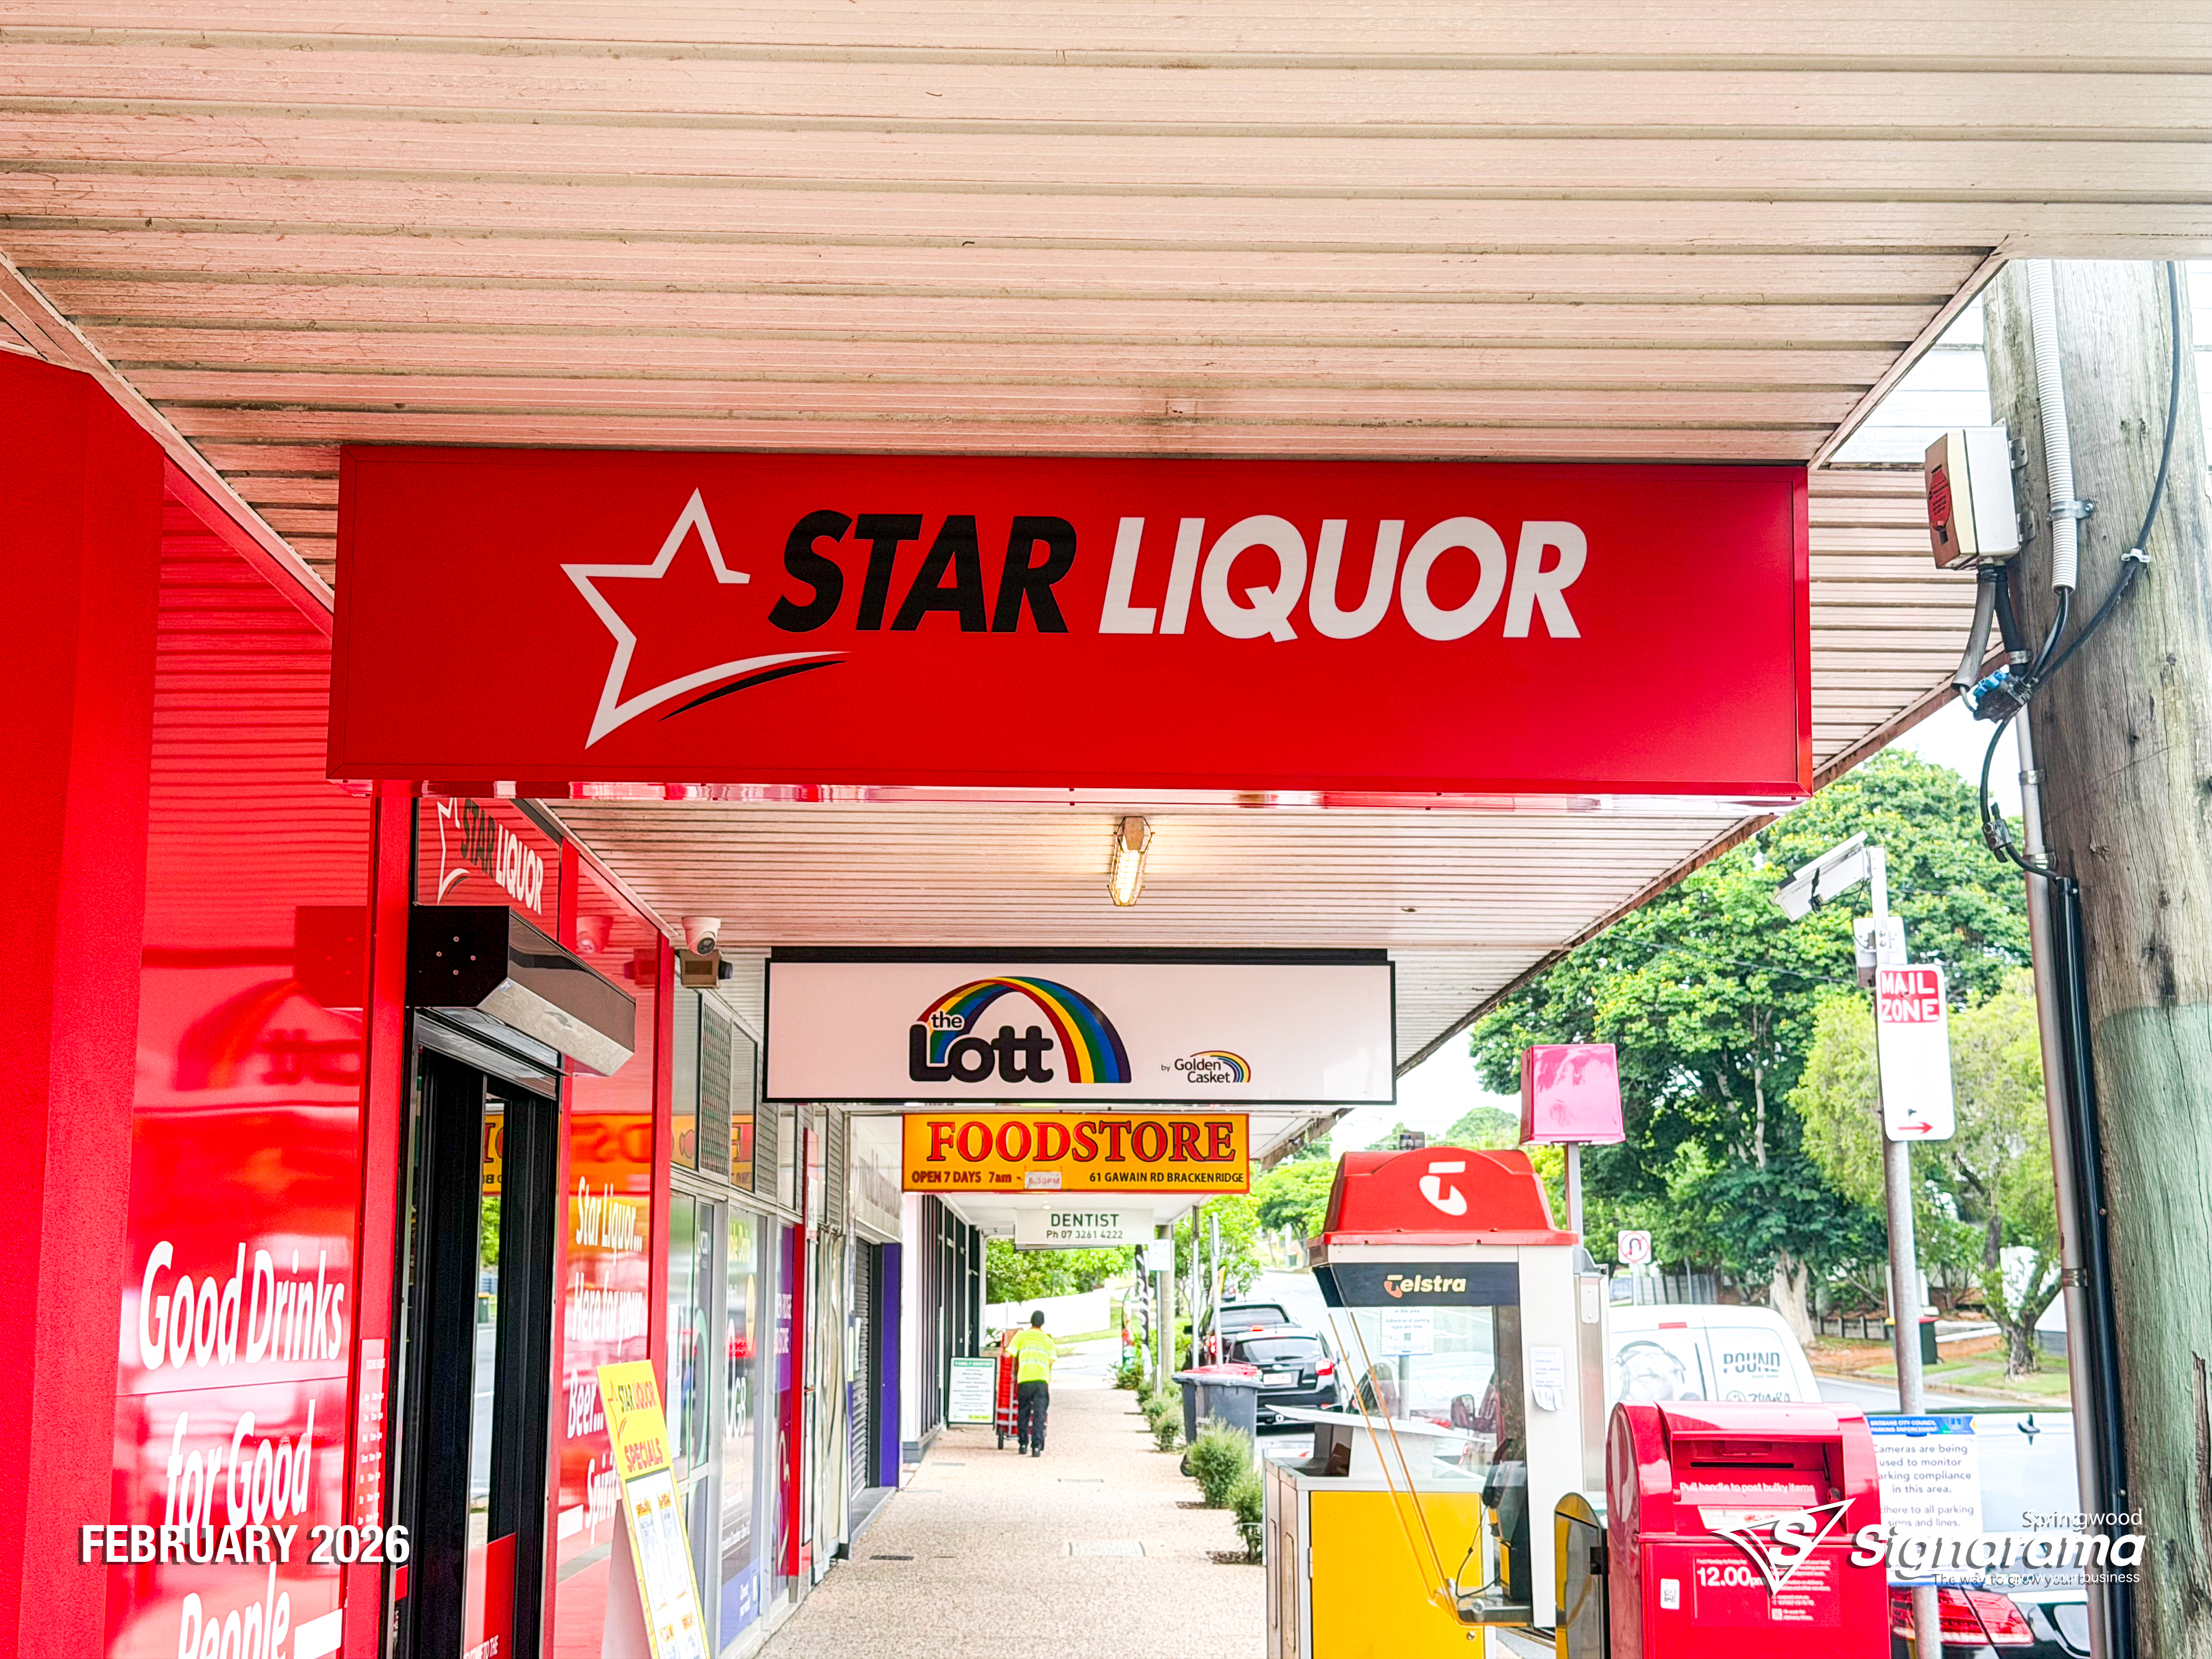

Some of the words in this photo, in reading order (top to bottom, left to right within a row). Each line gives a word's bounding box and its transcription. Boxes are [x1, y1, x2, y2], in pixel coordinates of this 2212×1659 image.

[768, 510, 1077, 633] STAR
[1098, 514, 1588, 643] LIQUOR
[460, 798, 495, 879] STAR
[495, 823, 543, 915] LIQUOR
[1881, 972, 1935, 995] MAIL
[931, 1011, 963, 1028] the
[1882, 999, 1939, 1021] ZONE
[909, 1024, 1054, 1083] Lott
[1174, 1058, 1221, 1071] Golden
[1187, 1071, 1231, 1083] Casket
[926, 1120, 1236, 1162] FOODSTORE
[911, 1170, 941, 1183] OPEN
[944, 1171, 950, 1182] 7
[953, 1171, 981, 1183] DAYS
[988, 1171, 1012, 1183] 7am
[1089, 1172, 1101, 1182] 61
[1104, 1172, 1147, 1182] GAWAIN
[1150, 1173, 1164, 1182] RD
[1167, 1173, 1244, 1183] BRACKENRIDGE
[576, 1176, 602, 1246] Star
[1051, 1214, 1119, 1227] DENTIST
[1046, 1230, 1058, 1238] Ph
[1384, 1274, 1466, 1298] Telstra
[139, 1240, 246, 1370] Good
[246, 1249, 345, 1364] Drinks
[572, 1272, 601, 1341] Here
[602, 1269, 619, 1339] for
[617, 1290, 643, 1357] your
[1723, 1352, 1780, 1373] POUND
[618, 1384, 635, 1413] STAR
[624, 1437, 663, 1472] SPECIALS
[1873, 1444, 1916, 1453] Cameras
[1938, 1443, 1968, 1455] being
[1880, 1457, 1903, 1466] used
[1921, 1457, 1962, 1466] monitor
[165, 1412, 222, 1547] for
[227, 1399, 316, 1531] Good
[1878, 1470, 1910, 1482] arking
[1914, 1470, 1971, 1482] compliance
[1680, 1482, 1697, 1492] Pull
[1699, 1482, 1729, 1492] handle
[1730, 1483, 1741, 1492] to
[1742, 1483, 1762, 1492] post
[1763, 1482, 1788, 1492] bulky
[1892, 1484, 1901, 1493] in
[1905, 1484, 1923, 1493] this
[1881, 1505, 1908, 1514] dhere
[1925, 1504, 1934, 1514] all
[1938, 1504, 1974, 1516] parking
[1915, 1517, 1933, 1527] and
[1936, 1518, 1960, 1527] lines.
